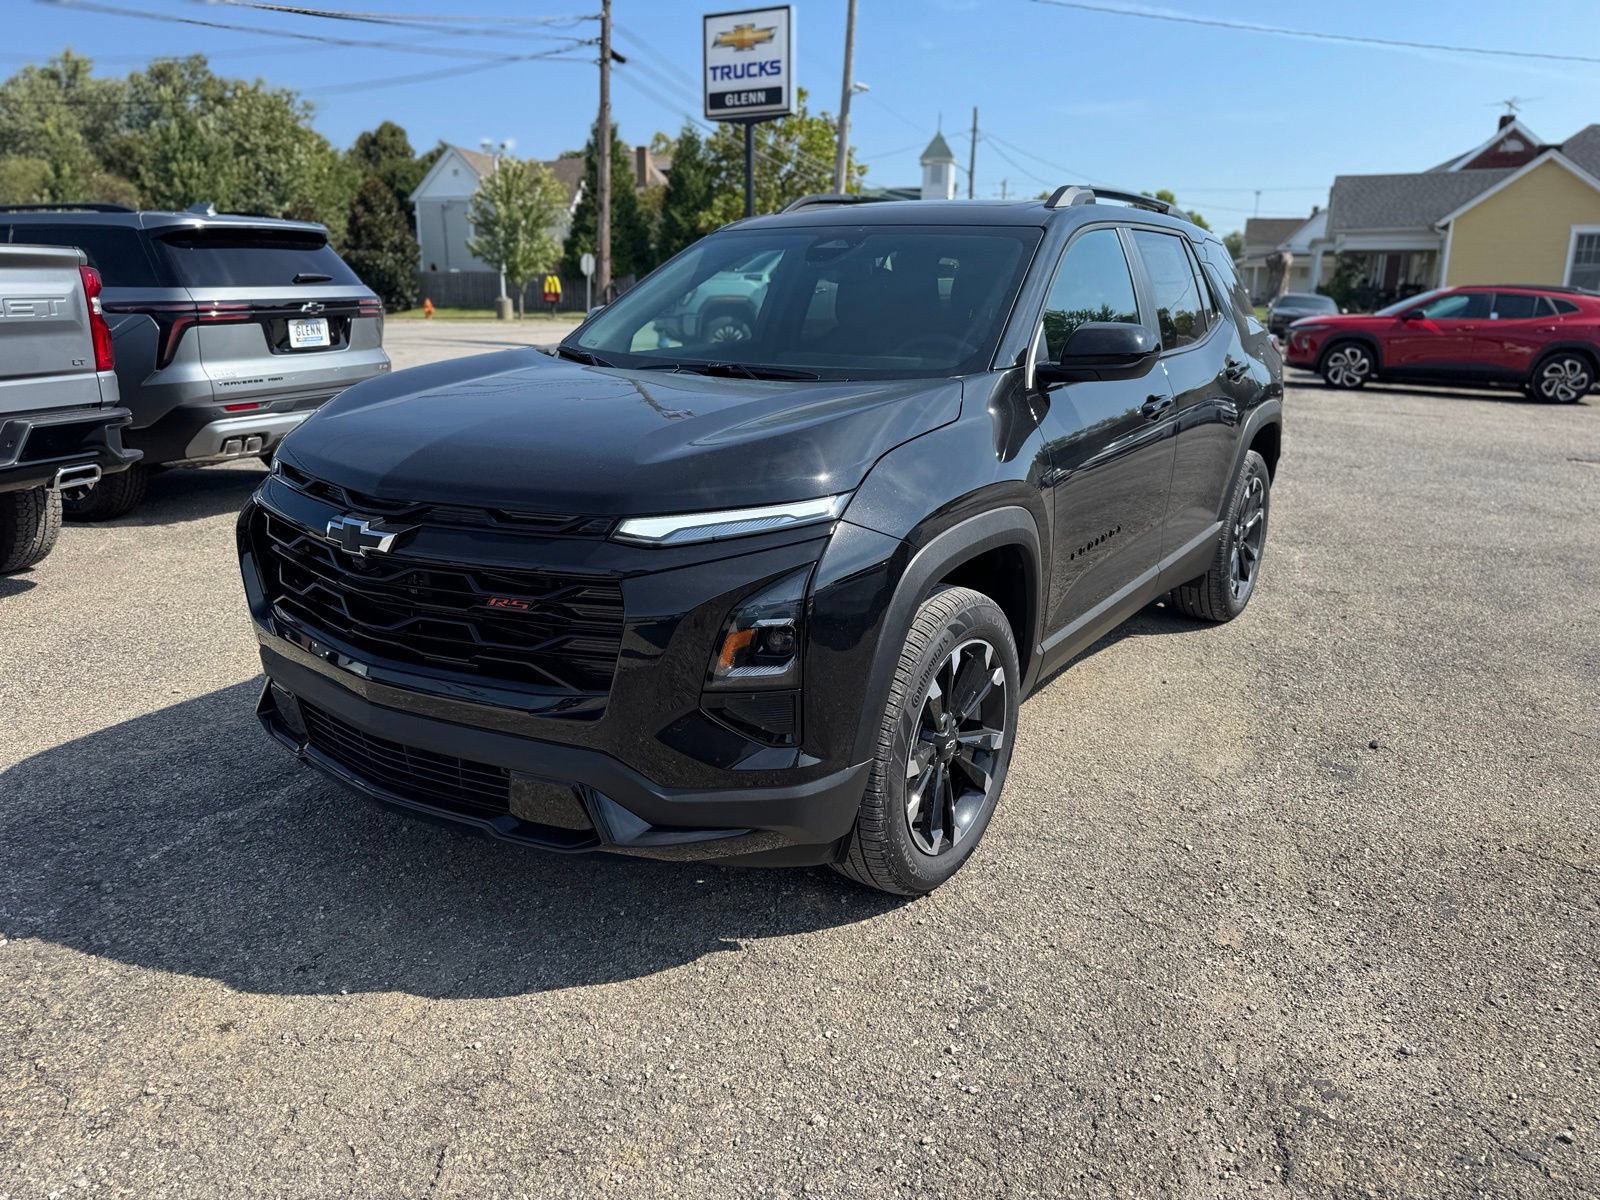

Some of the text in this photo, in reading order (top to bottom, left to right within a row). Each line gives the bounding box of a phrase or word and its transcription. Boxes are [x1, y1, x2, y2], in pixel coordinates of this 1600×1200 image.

[709, 60, 782, 81] TRUCKS
[724, 91, 766, 106] GLENN
[0, 296, 66, 318] ET
[295, 324, 322, 337] GLENN
[71, 359, 85, 367] LT
[487, 597, 530, 610] RS
[911, 643, 944, 709] Continental
